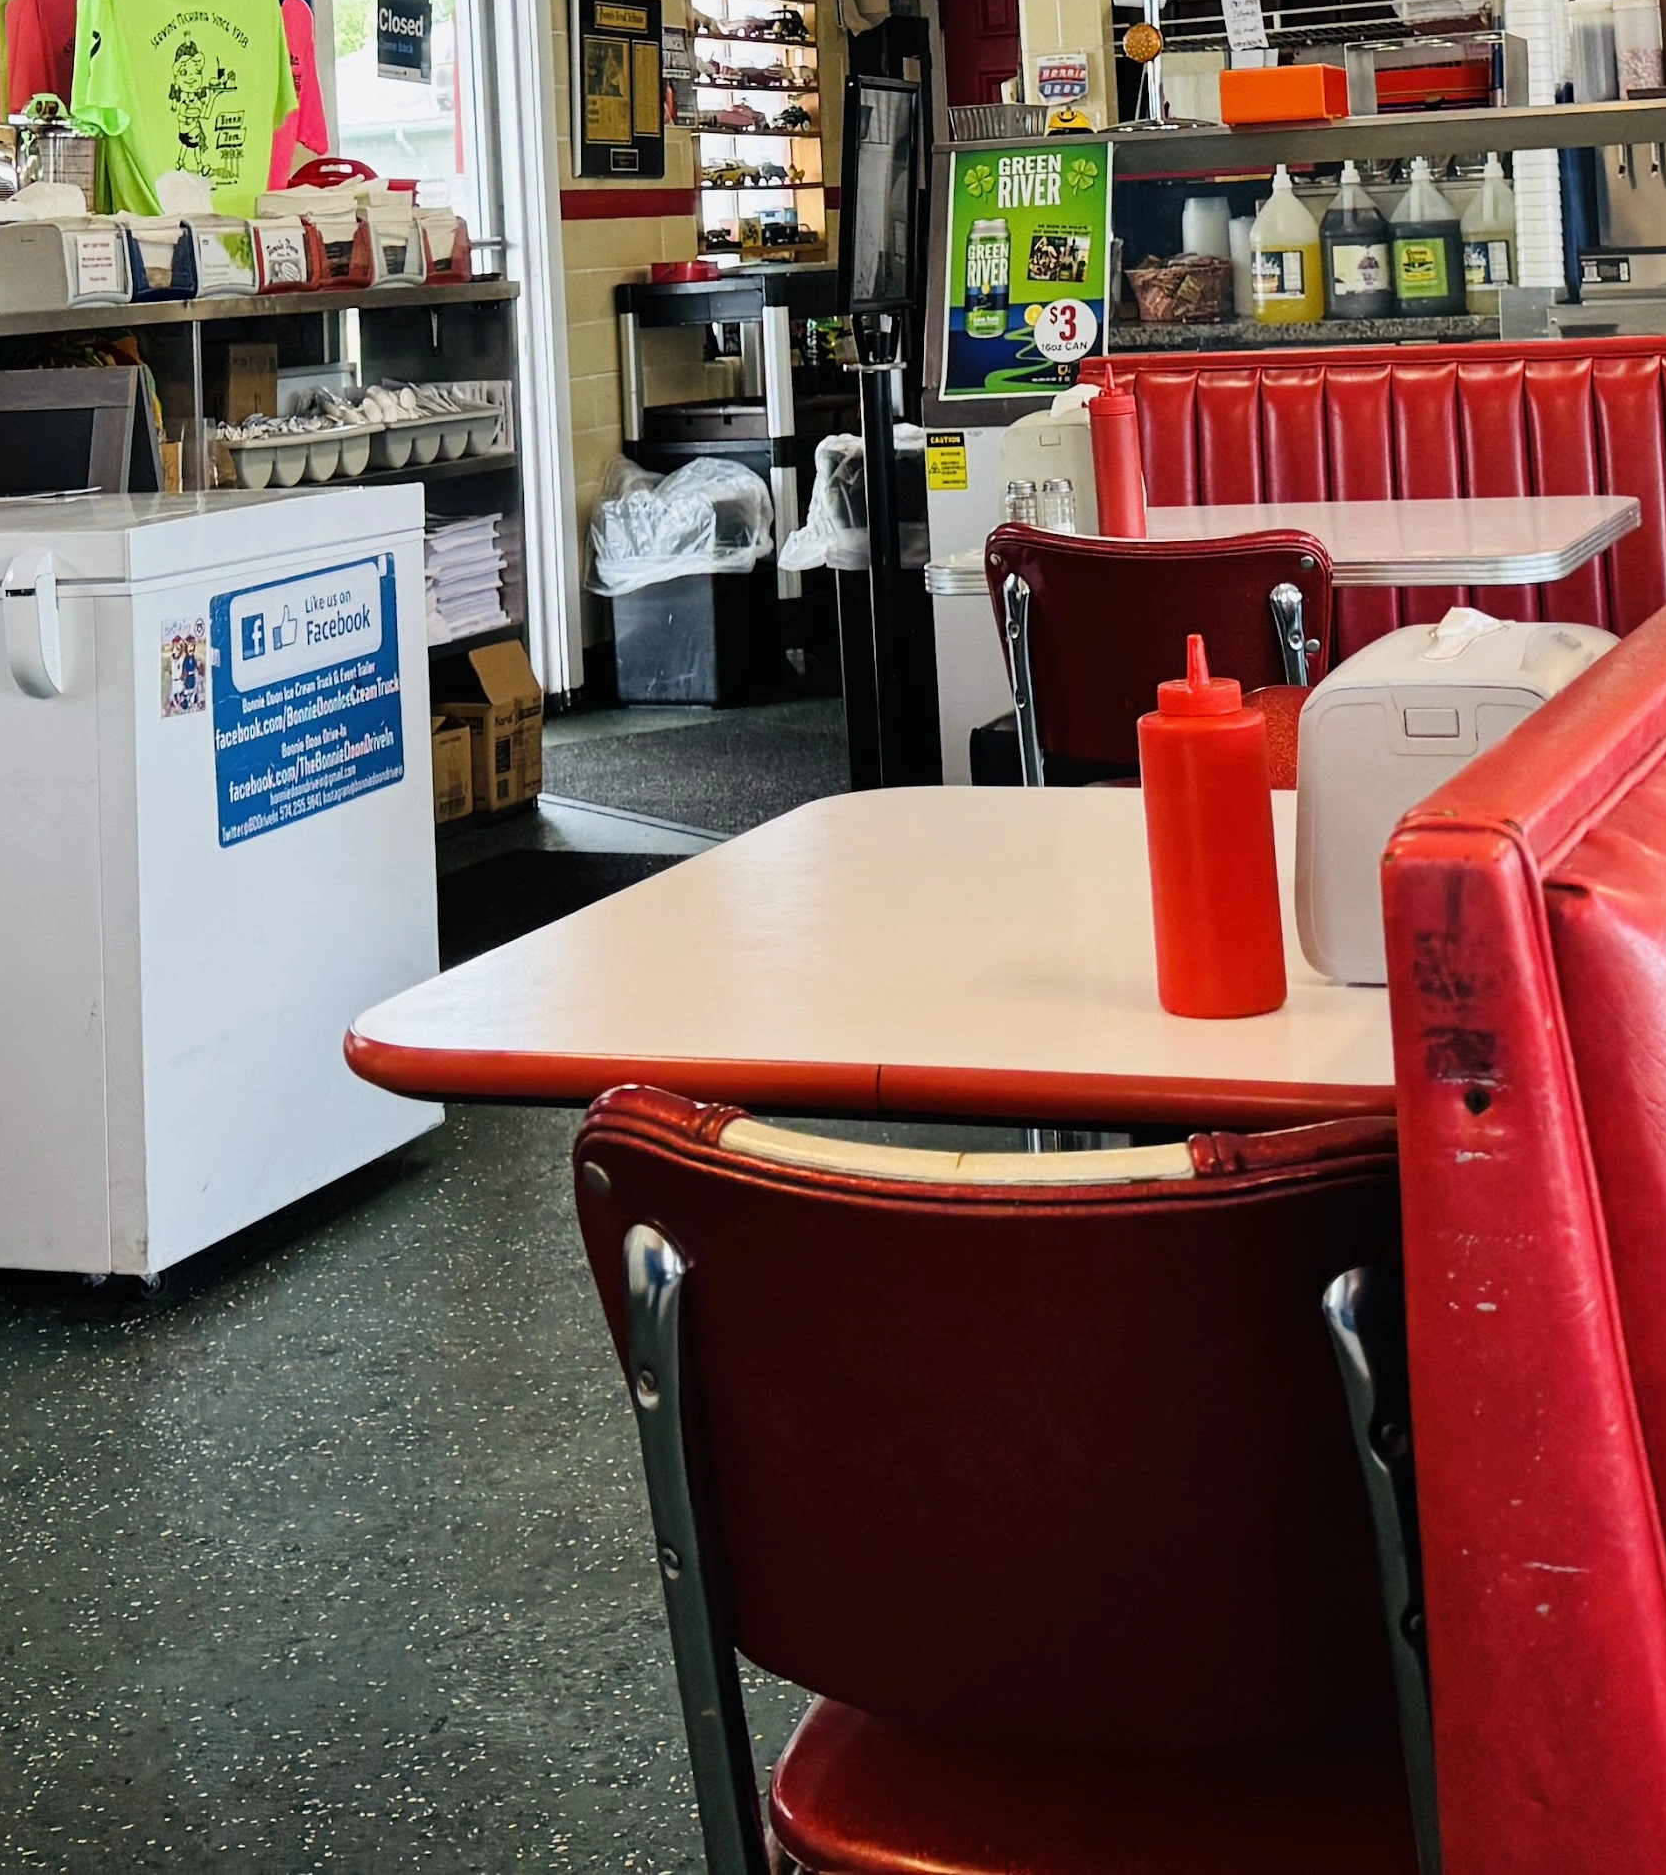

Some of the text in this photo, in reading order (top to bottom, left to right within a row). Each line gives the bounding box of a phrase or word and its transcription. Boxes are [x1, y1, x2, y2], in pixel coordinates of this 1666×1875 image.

[378, 7, 425, 38] Closed
[998, 153, 1063, 175] GREEN
[997, 172, 1062, 209] RIVER
[967, 243, 1009, 261] GREEN
[966, 257, 1009, 288] RIVER
[1049, 304, 1078, 342] $3
[1064, 340, 1088, 352] CAN
[930, 435, 961, 445] CAUTION
[305, 590, 351, 614] Like us on
[306, 604, 371, 646] Facebook
